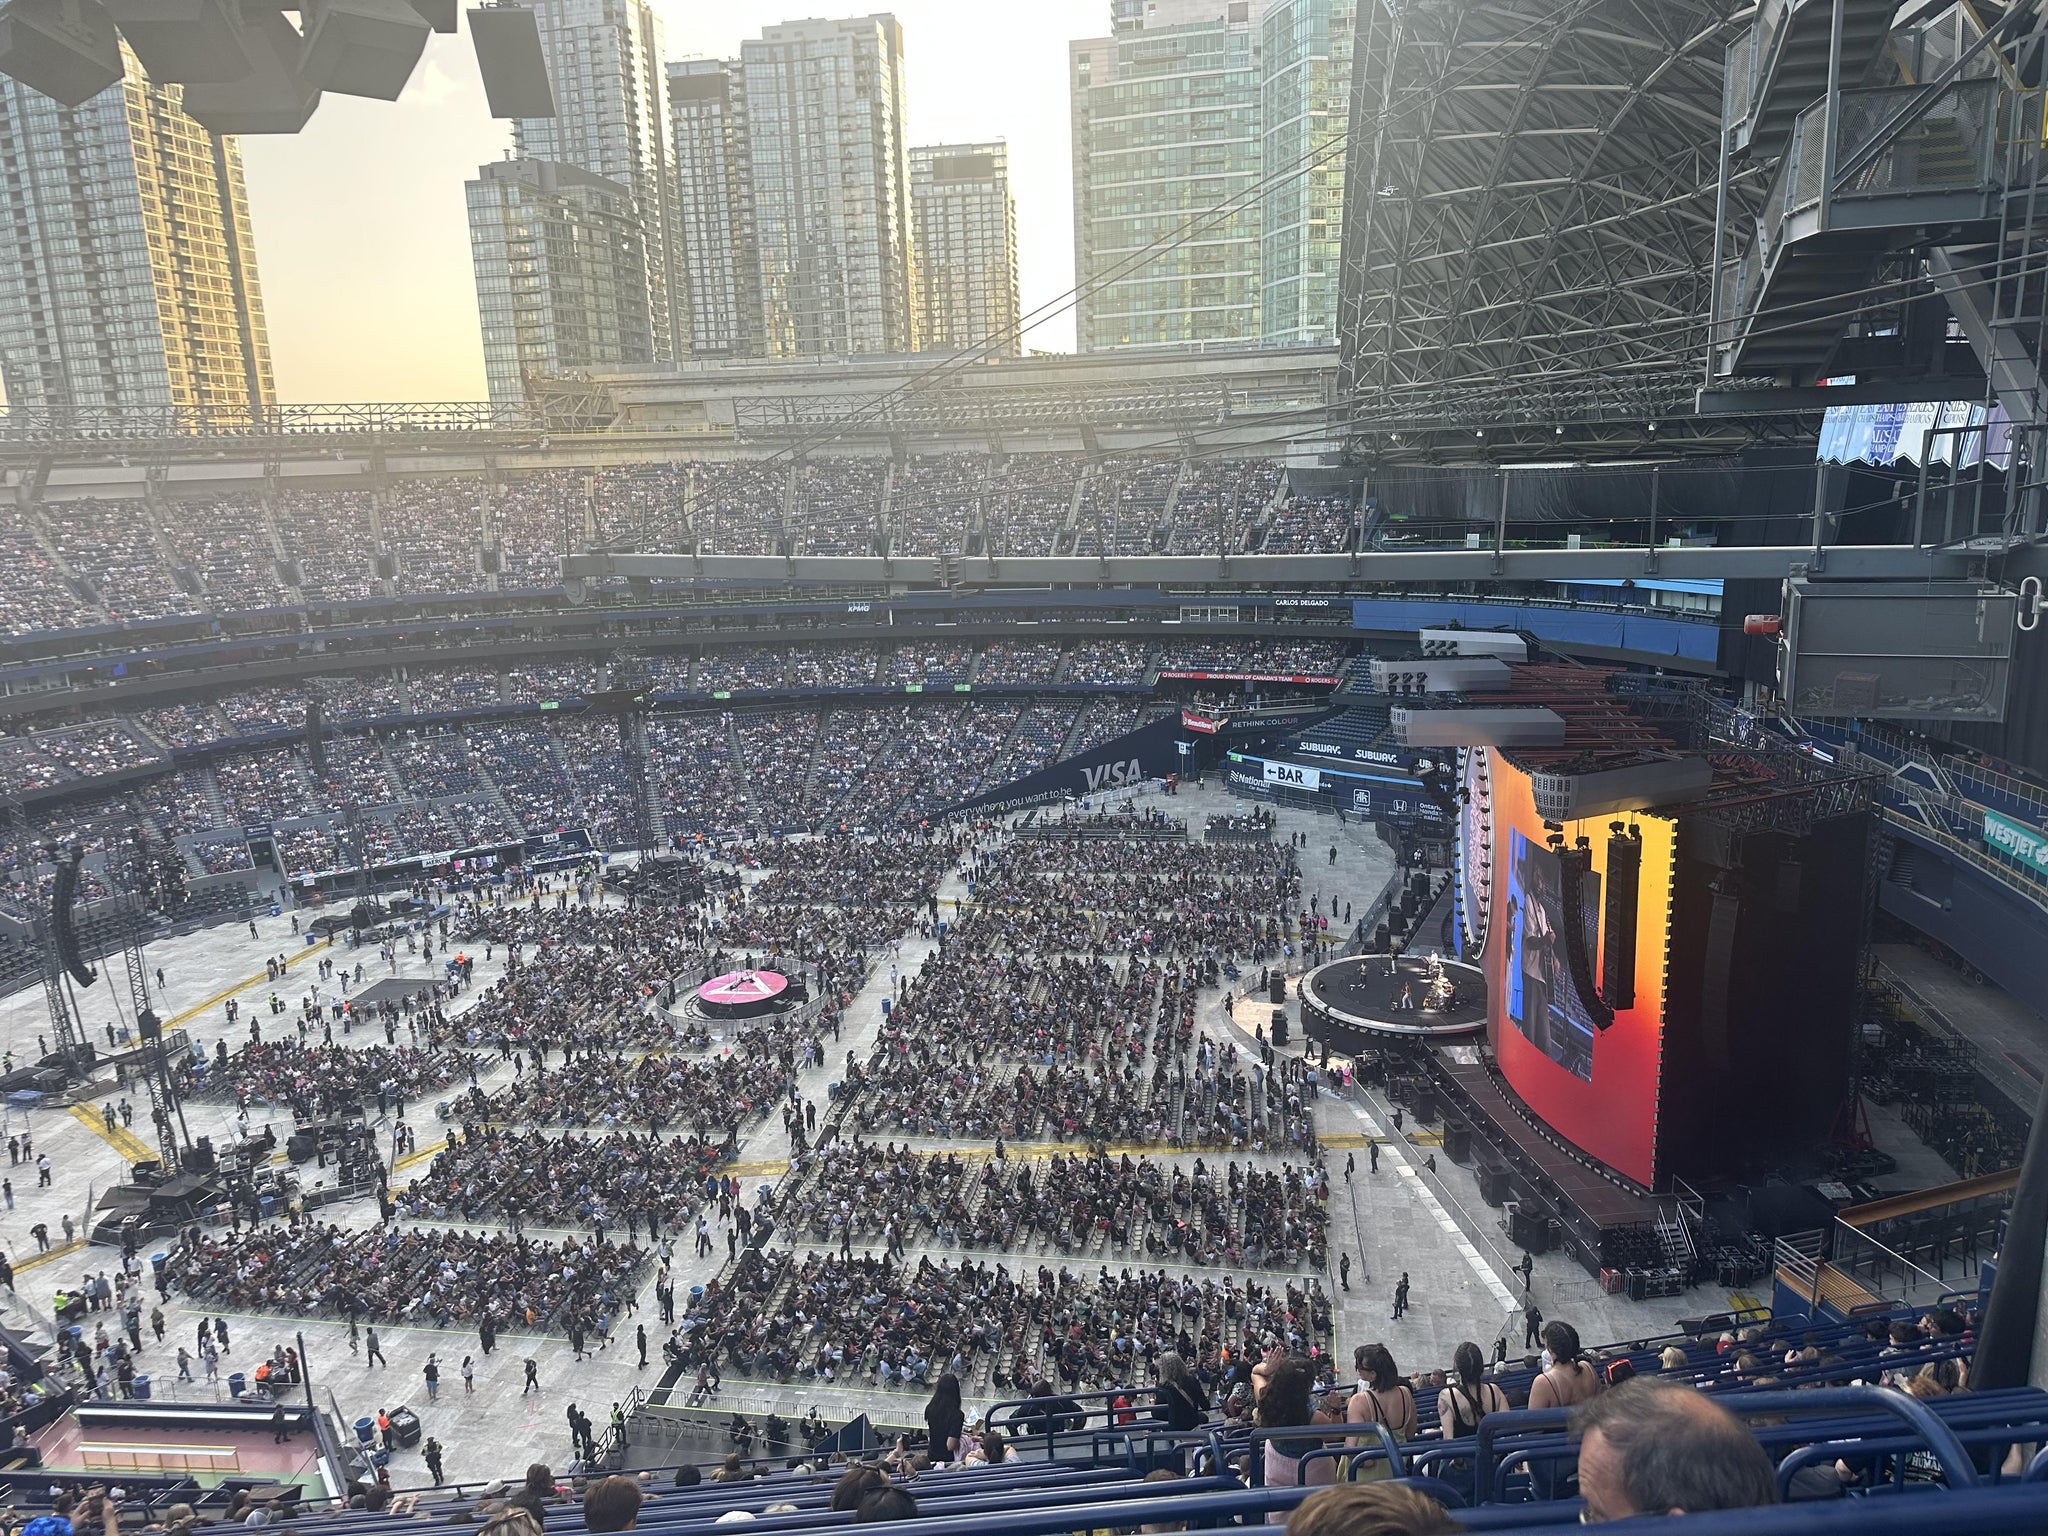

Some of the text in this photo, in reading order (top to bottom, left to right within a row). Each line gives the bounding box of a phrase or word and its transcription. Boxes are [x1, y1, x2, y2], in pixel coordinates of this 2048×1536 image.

[847, 604, 870, 613] KPMG
[1232, 717, 1298, 729] RETHINK COLOUR
[1299, 741, 1341, 755] SUBWAY
[1355, 749, 1398, 763] SUBWAY
[1079, 758, 1142, 791] VISA
[1238, 773, 1271, 788] National
[1277, 766, 1304, 784] BAR
[1006, 797, 1024, 808] you
[1024, 791, 1049, 803] want
[1049, 789, 1060, 799] to
[1060, 786, 1072, 796] be
[1984, 815, 2039, 858] WESTJET
[425, 857, 447, 866] MERCH
